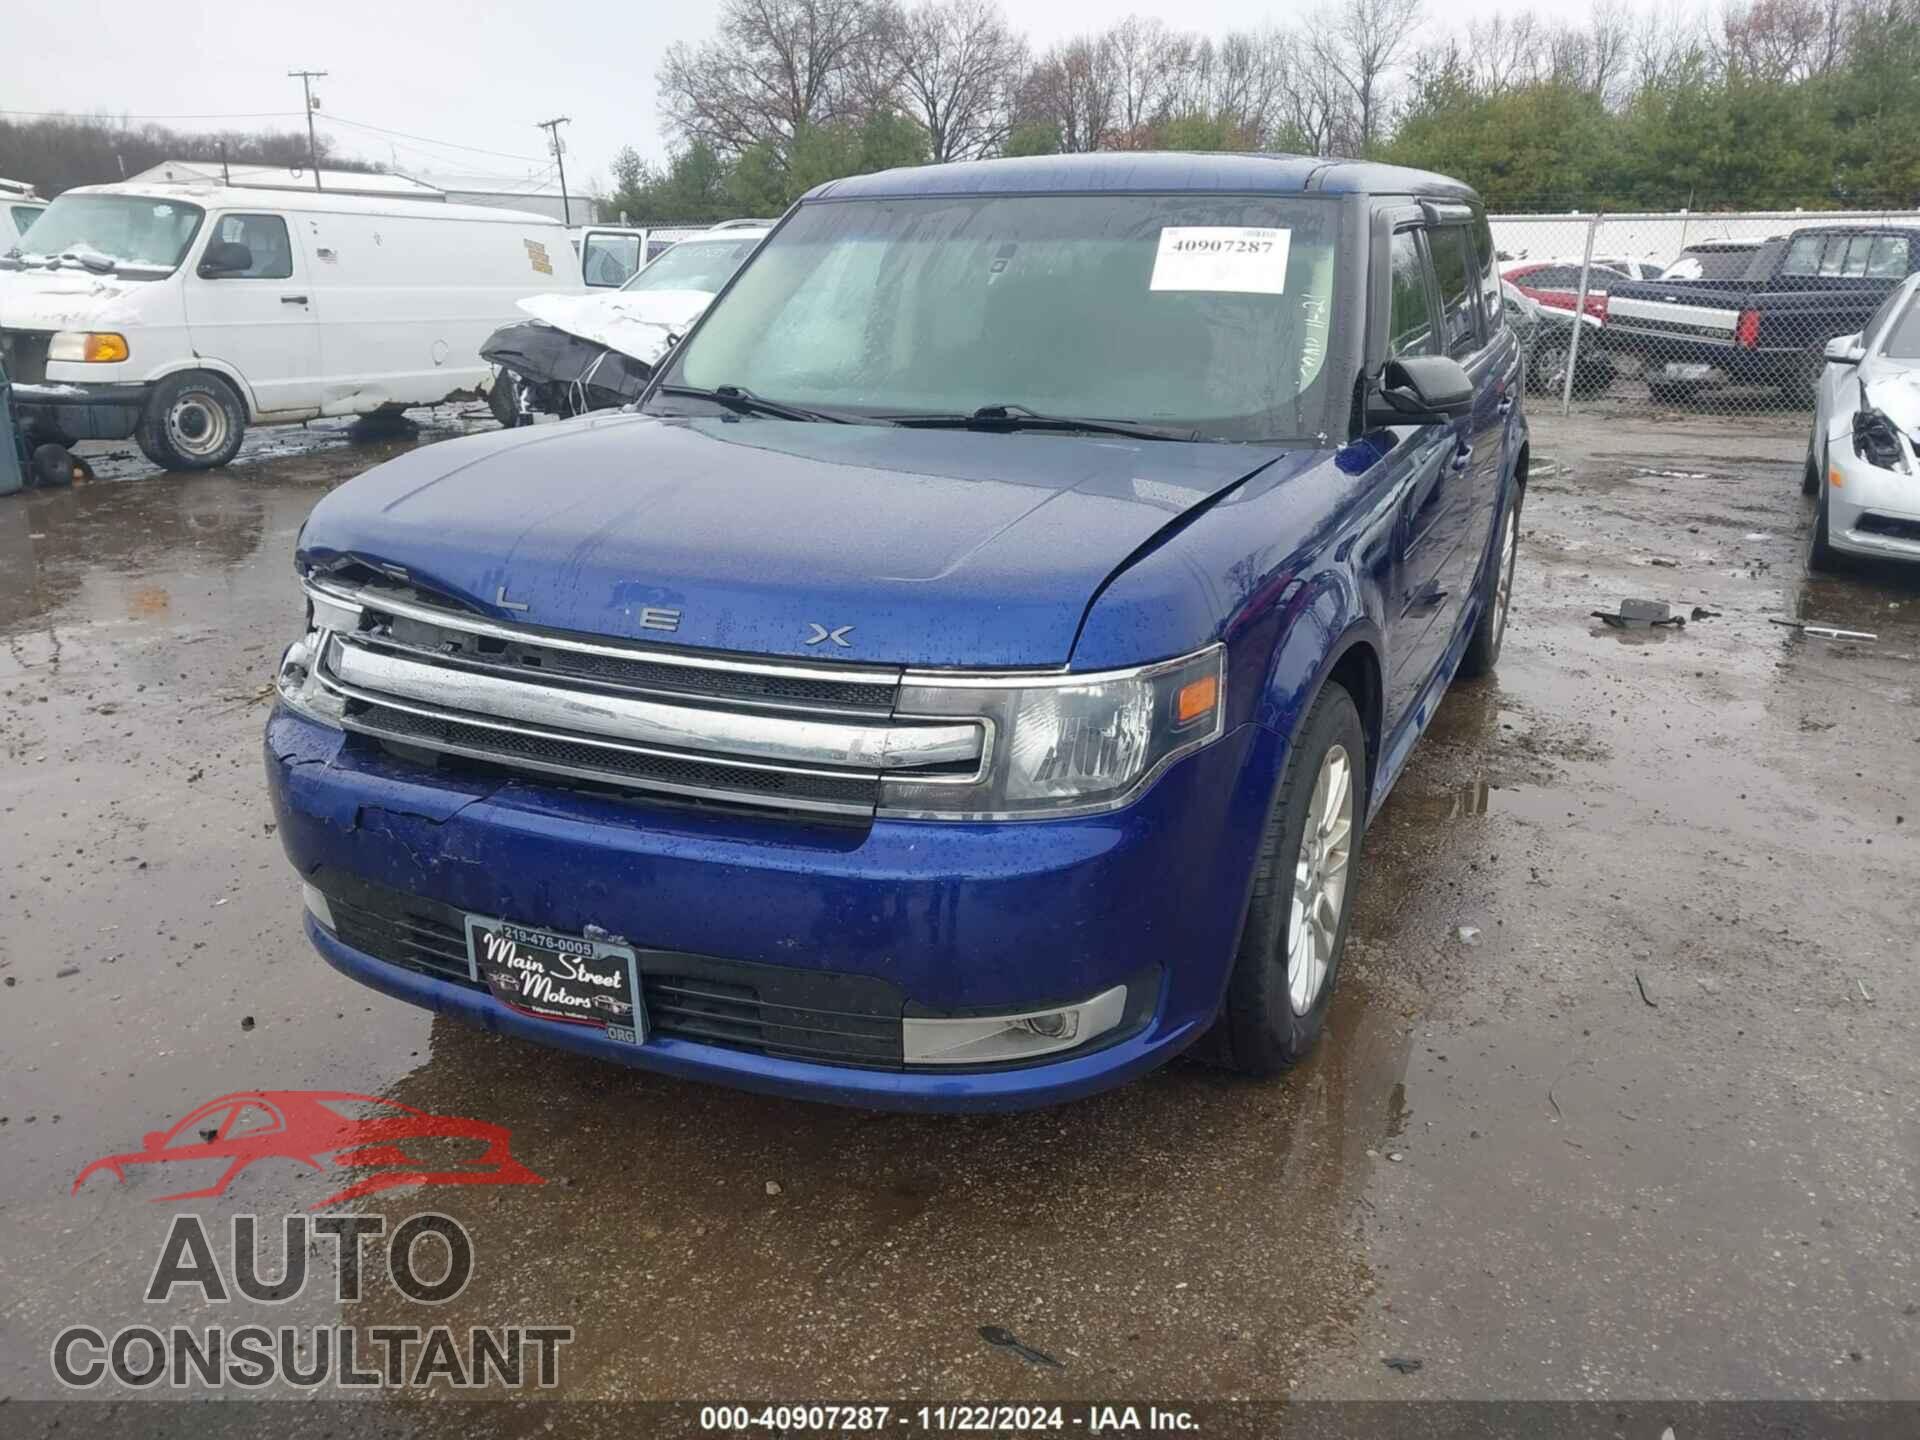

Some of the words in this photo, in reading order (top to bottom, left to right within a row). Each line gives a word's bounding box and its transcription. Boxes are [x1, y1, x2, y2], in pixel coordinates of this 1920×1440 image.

[1172, 239, 1273, 253] 40907287
[503, 926, 592, 955] 219-476-0005
[483, 933, 544, 974] Main
[549, 952, 622, 989] Street
[519, 970, 592, 1009] Motors
[607, 1025, 636, 1043] ORG
